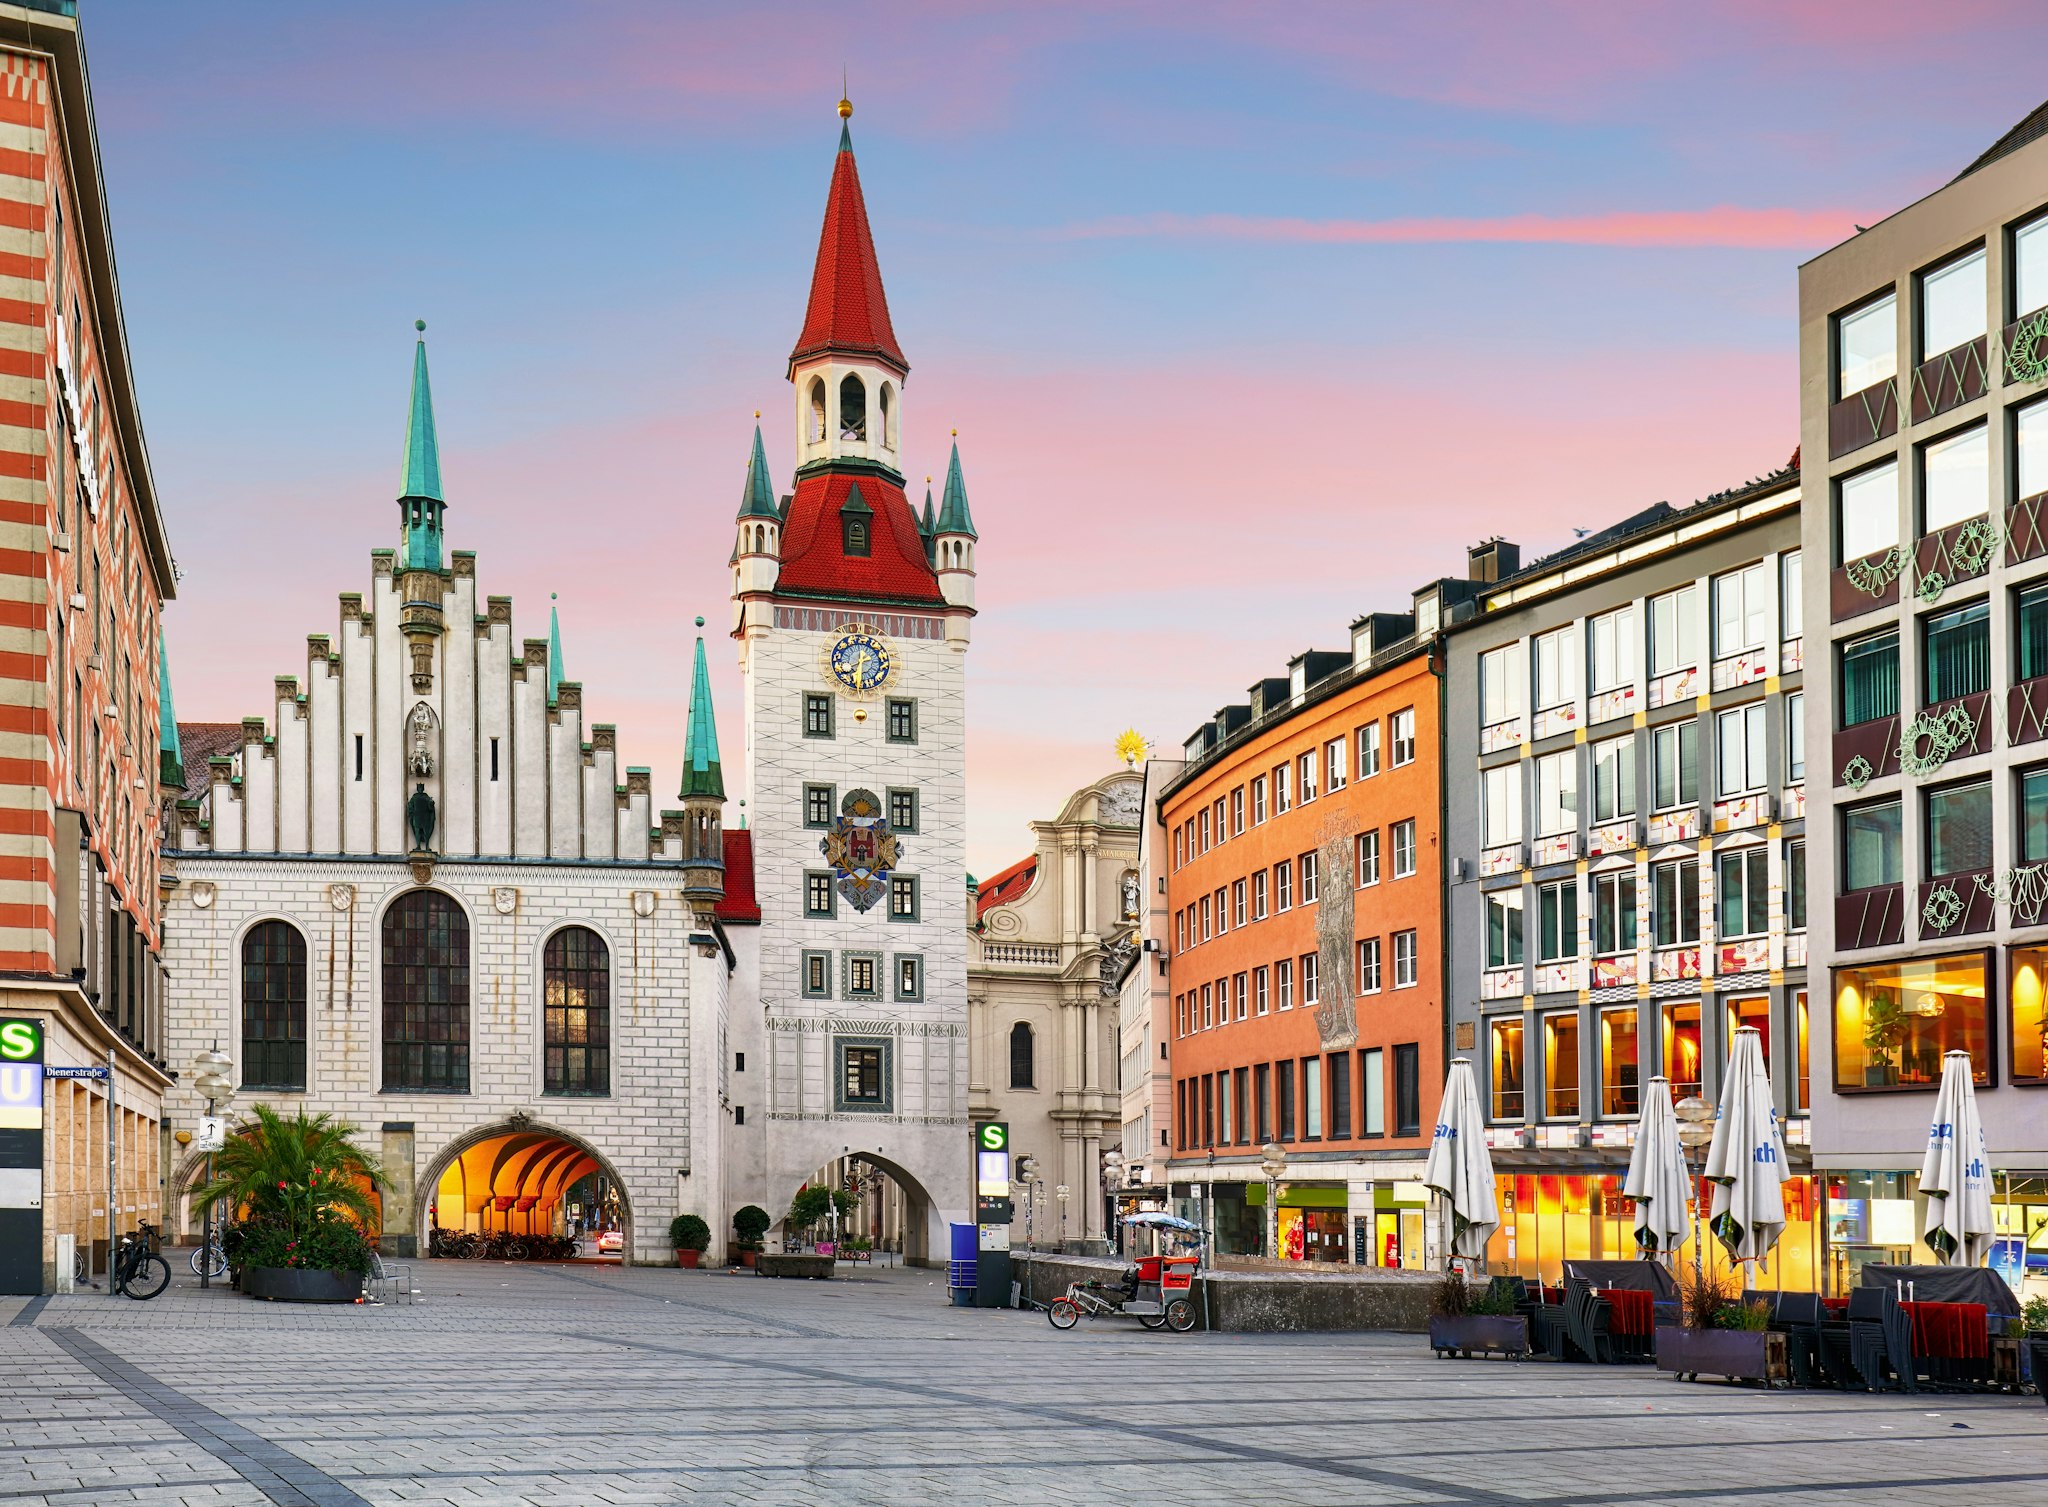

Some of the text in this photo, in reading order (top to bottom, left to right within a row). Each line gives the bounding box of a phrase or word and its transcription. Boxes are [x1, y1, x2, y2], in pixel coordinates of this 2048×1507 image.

[2, 1023, 34, 1057] S
[1, 1068, 31, 1102] U
[46, 1067, 102, 1078] Dienerstraße
[984, 1125, 1004, 1150] S
[984, 1155, 1002, 1178] U
